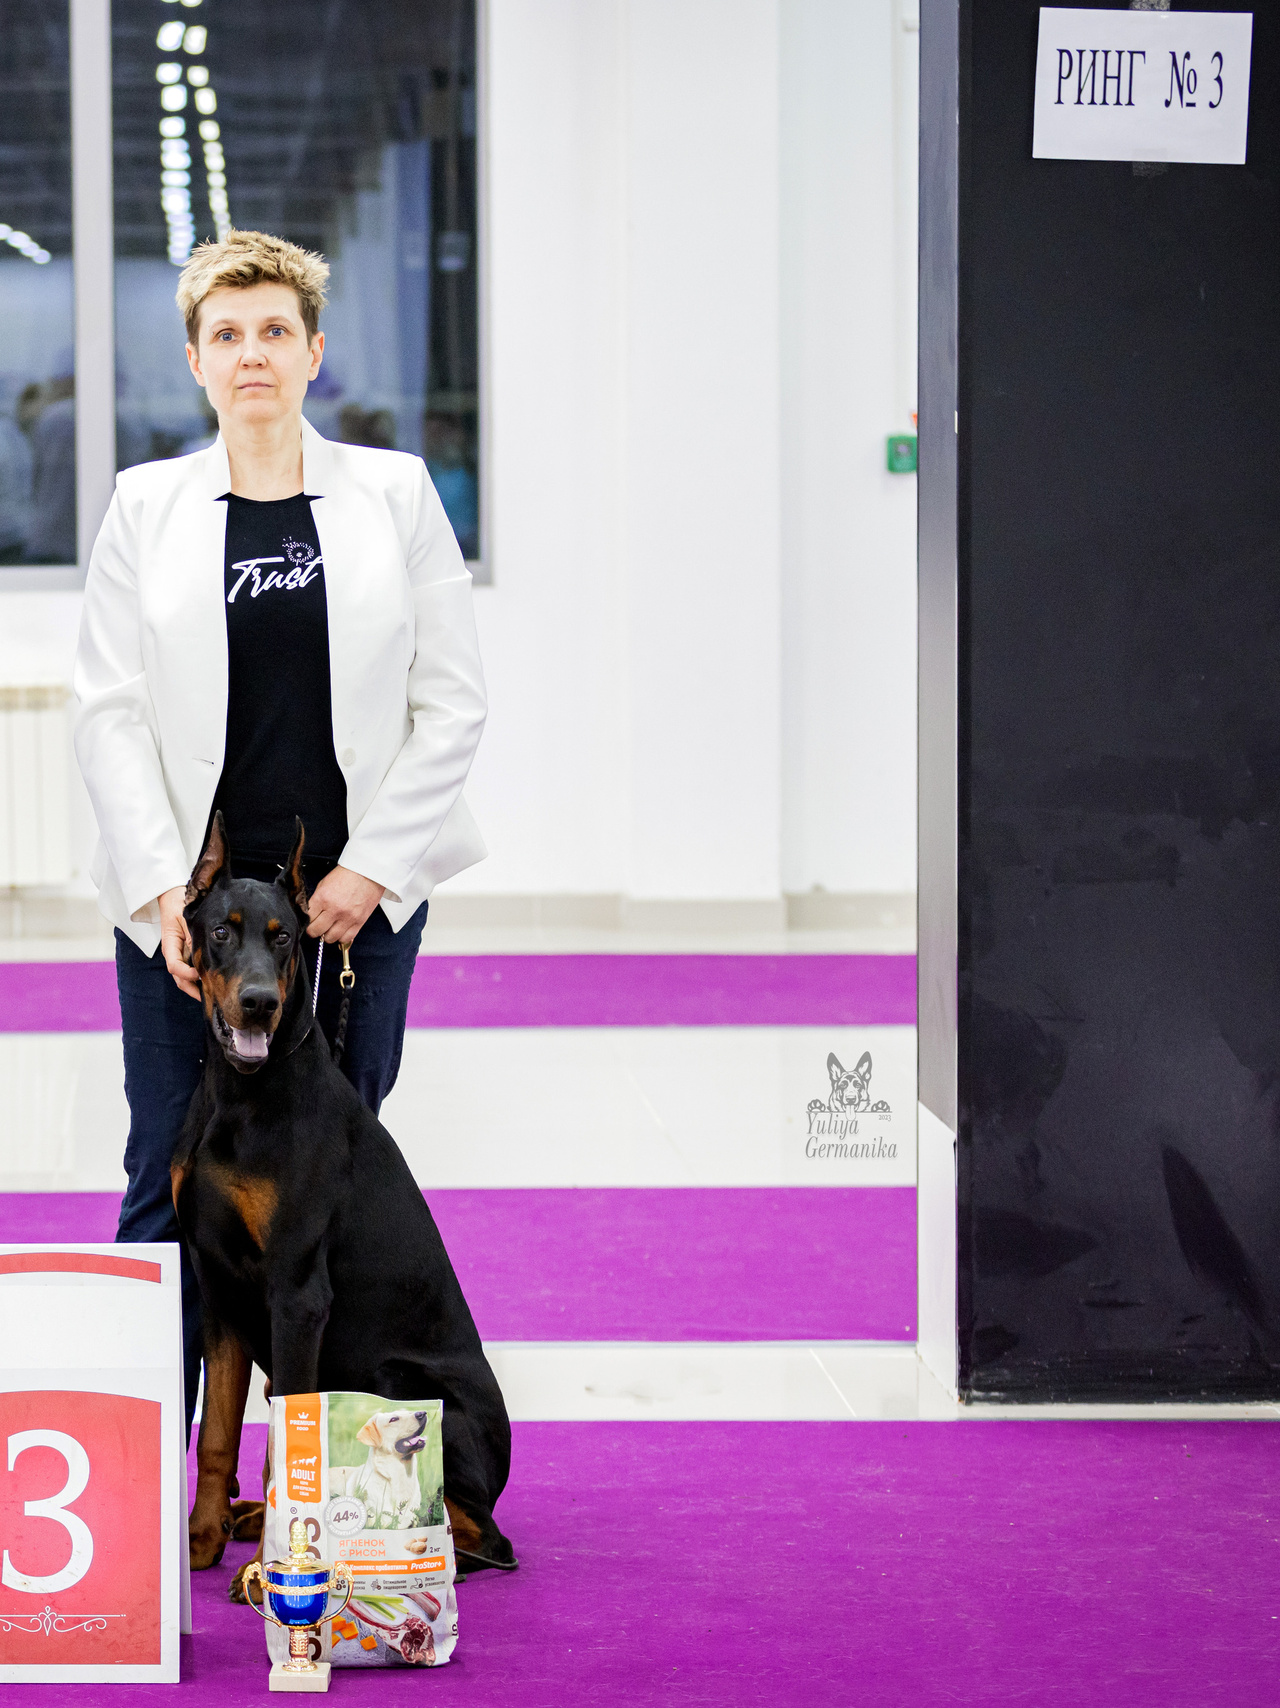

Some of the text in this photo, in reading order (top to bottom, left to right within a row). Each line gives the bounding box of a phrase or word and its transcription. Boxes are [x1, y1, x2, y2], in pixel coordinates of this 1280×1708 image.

[1054, 48, 1224, 109] РИНГ № 3
[227, 555, 323, 604] Trust
[291, 1468, 316, 1481] ADULT
[1, 1428, 94, 1594] 3
[332, 1510, 359, 1523] 44%
[338, 1538, 385, 1548] ЯГНЕНОК
[338, 1549, 386, 1557] С РИСОМ
[410, 1561, 442, 1570] ProStor+
